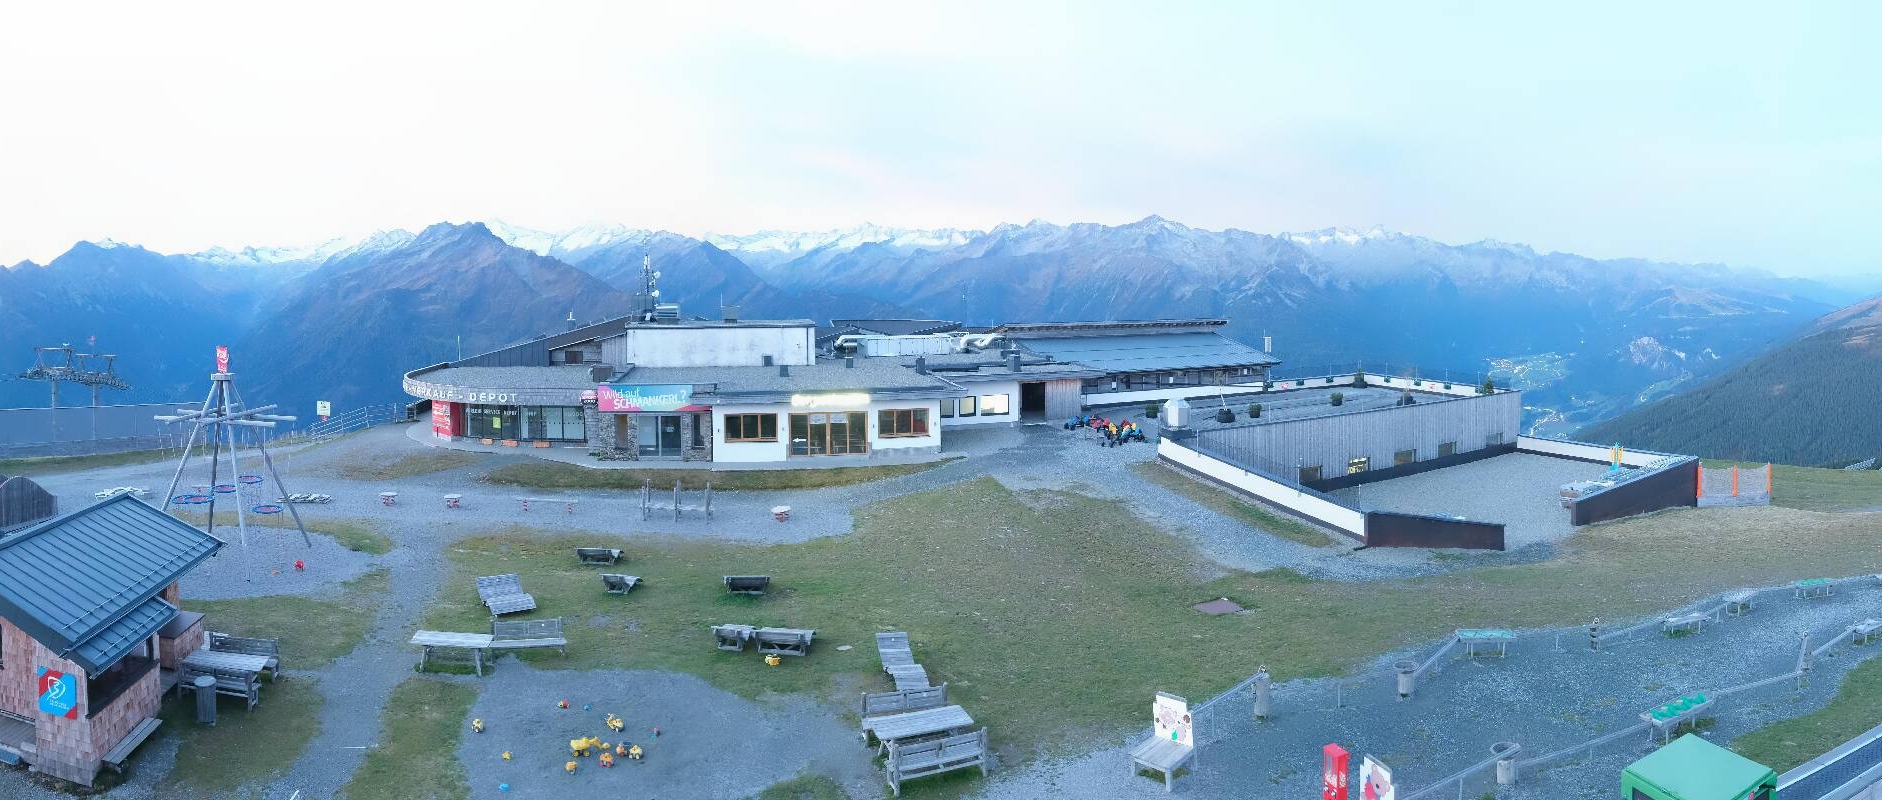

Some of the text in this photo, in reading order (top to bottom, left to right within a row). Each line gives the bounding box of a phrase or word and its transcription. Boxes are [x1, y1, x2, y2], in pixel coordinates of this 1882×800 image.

[411, 386, 453, 400] VERKAUF
[603, 387, 640, 399] Wild auf
[613, 391, 687, 409] SCHMANKERL?
